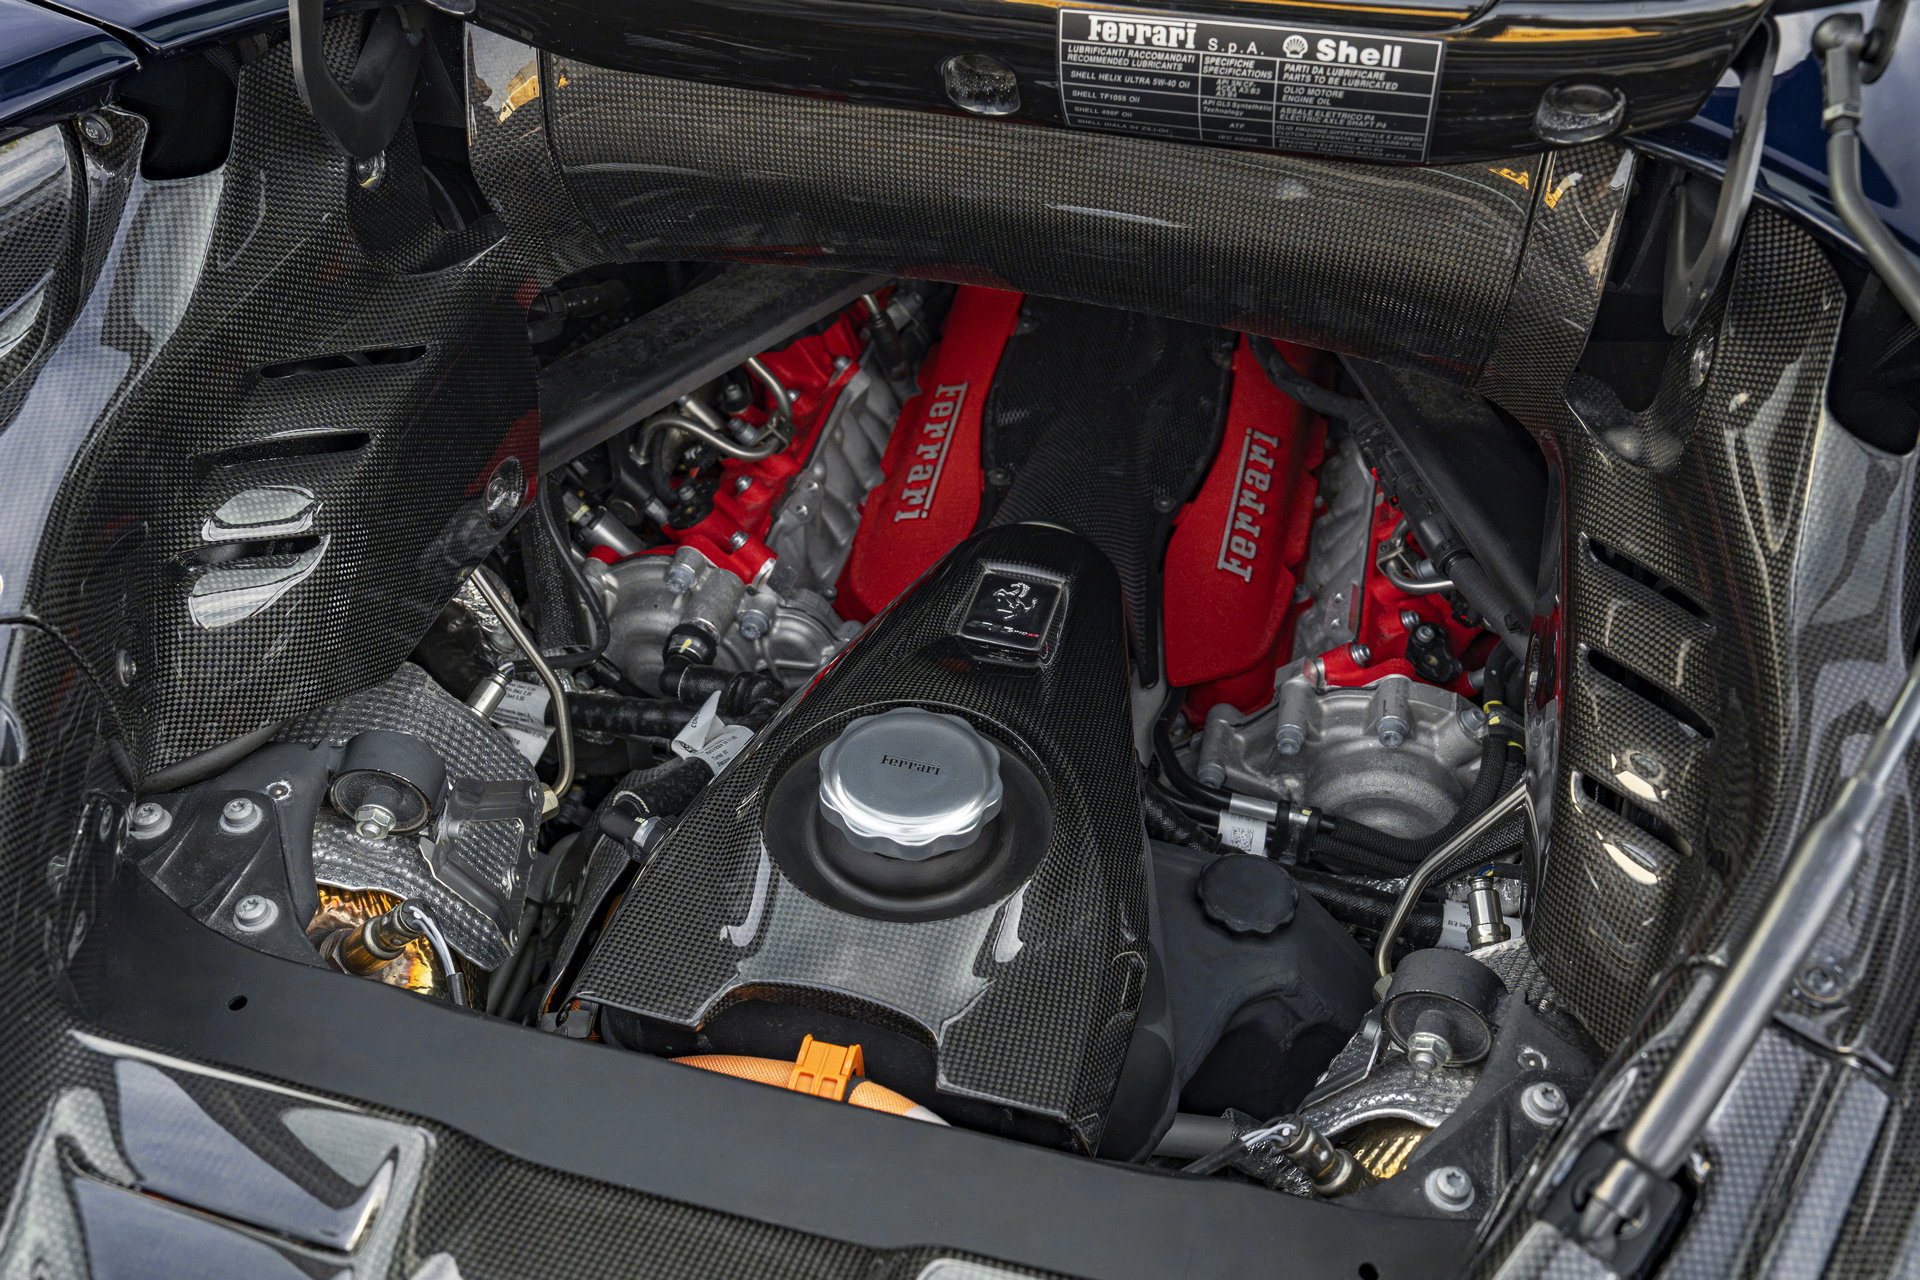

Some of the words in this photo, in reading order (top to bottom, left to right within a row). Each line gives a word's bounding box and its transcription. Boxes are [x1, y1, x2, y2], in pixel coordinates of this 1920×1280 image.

[1088, 14, 1197, 49] Ferrari
[1068, 44, 1125, 57] LUBRIFICANTI
[1128, 49, 1195, 63] RACCOMANDATI
[1316, 38, 1402, 68] Shell
[1067, 54, 1129, 66] RECOMMENDED
[1131, 59, 1184, 71] LUBRICANTS
[1204, 56, 1256, 68] SPECIFICHE
[1070, 70, 1096, 80] SHELL
[1098, 73, 1122, 82] HELIX
[1124, 75, 1150, 86] ULTRA
[1152, 78, 1177, 88] 5W-40
[1178, 80, 1191, 88] Oil
[1203, 66, 1273, 79] SPECIFICATIONS
[1284, 63, 1310, 73] PARTI
[1312, 66, 1324, 75] DA
[1326, 67, 1386, 80] LUBRIFICARE
[1283, 73, 1312, 82] PARTS
[1314, 75, 1326, 84] TO
[1327, 77, 1340, 85] BE
[1342, 79, 1398, 90] LUBRICATED
[1072, 90, 1097, 99] SHELL
[1282, 94, 1315, 104] ENGINE
[1317, 98, 1331, 106] OIL
[1283, 86, 1305, 95] OLIO
[1306, 87, 1345, 98] MOTORE
[894, 381, 969, 523] Ferrari
[1217, 427, 1279, 583] Ferrari
[881, 754, 941, 776] Ferrari
